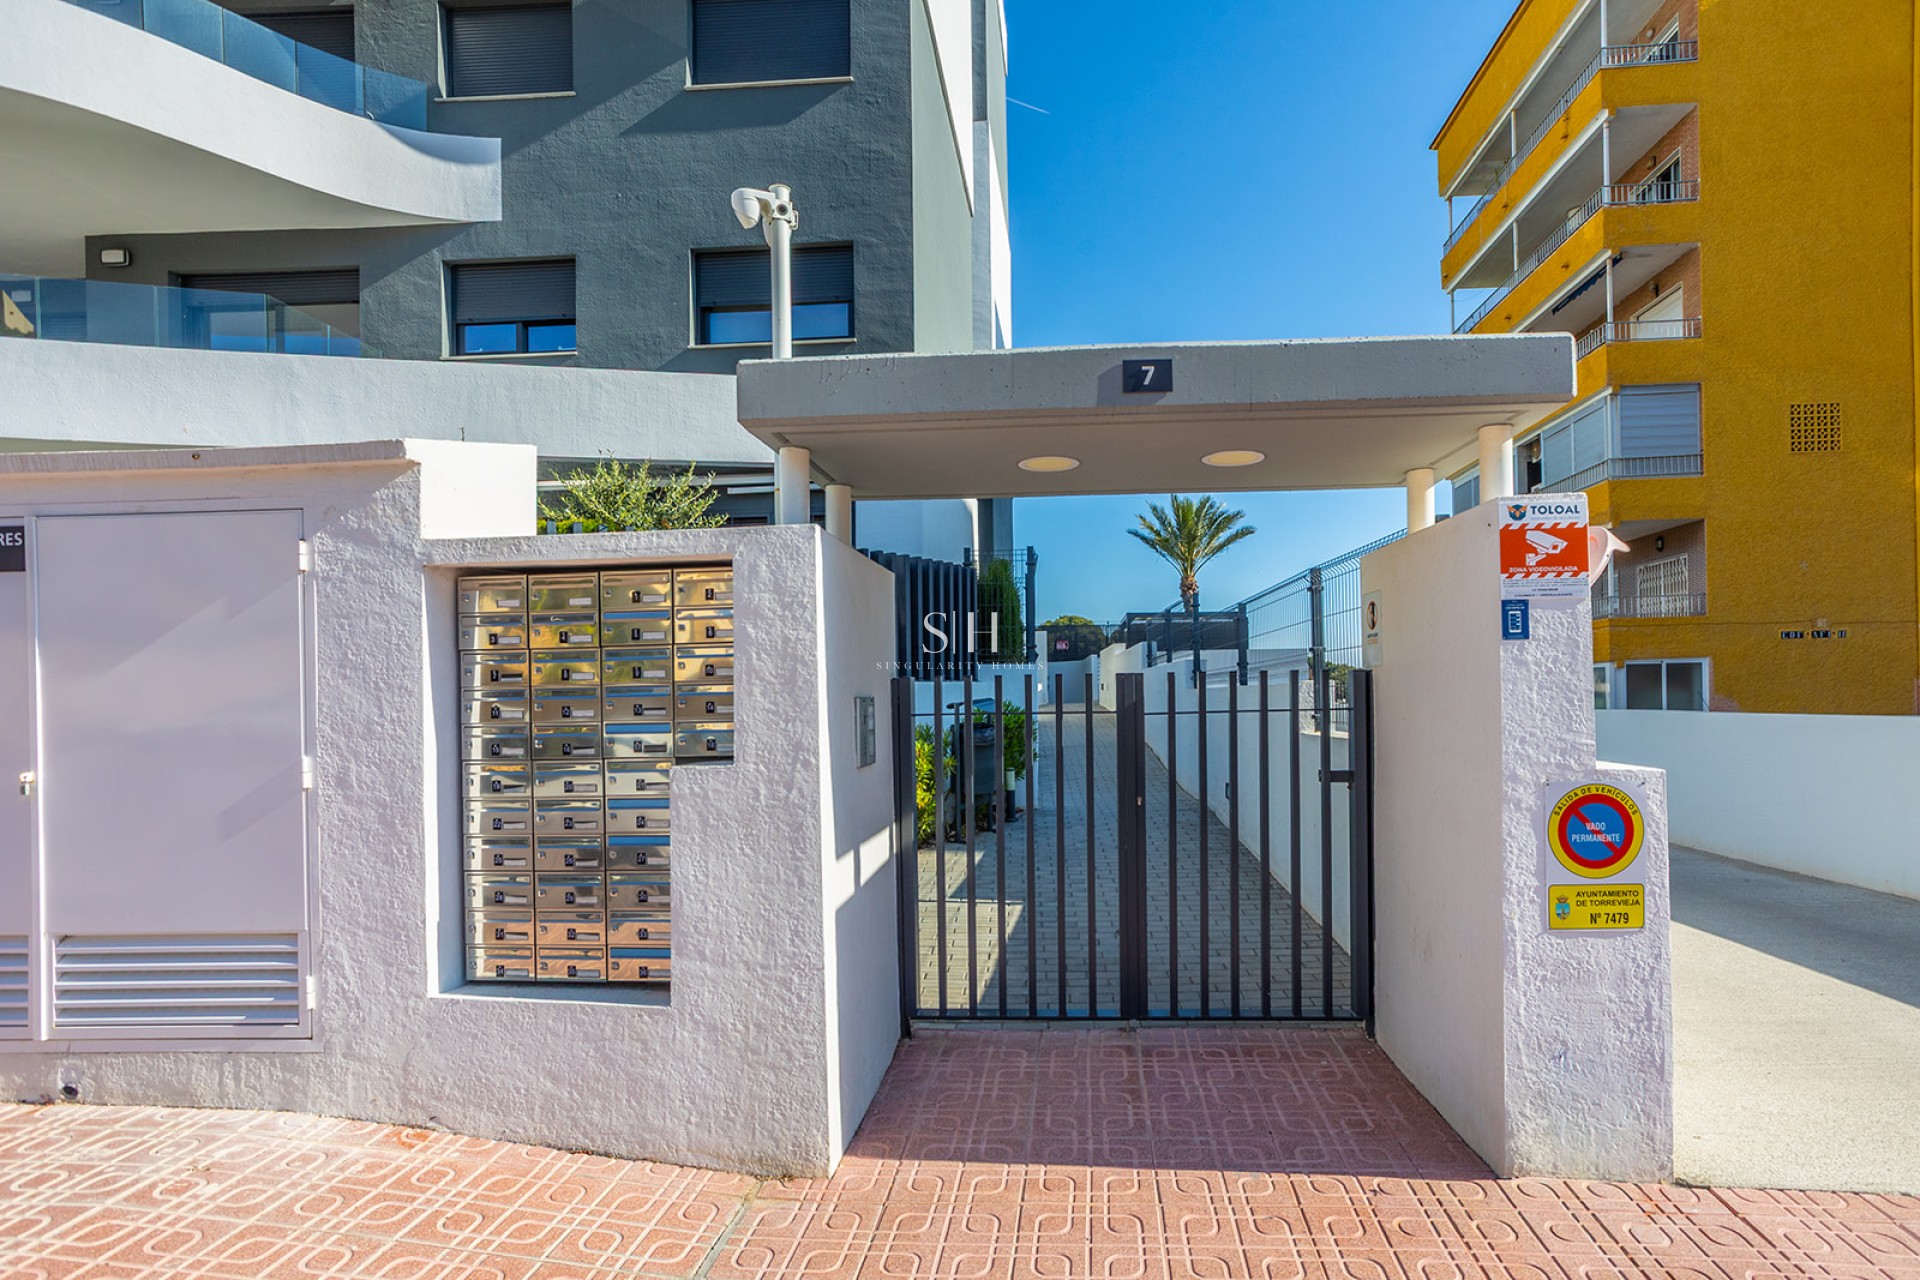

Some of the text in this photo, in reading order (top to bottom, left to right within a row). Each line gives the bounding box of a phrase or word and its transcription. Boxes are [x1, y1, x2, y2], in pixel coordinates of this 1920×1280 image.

[1141, 365, 1155, 386] 7
[1530, 504, 1580, 515] TOLOAL
[1554, 792, 1580, 816] SALIDA
[1580, 787, 1591, 795] DE
[1585, 822, 1606, 831] VADO
[1571, 833, 1620, 842] PERMANENTE
[1576, 899, 1640, 907] DE TORREVIEJA
[1604, 912, 1629, 924] 7479
